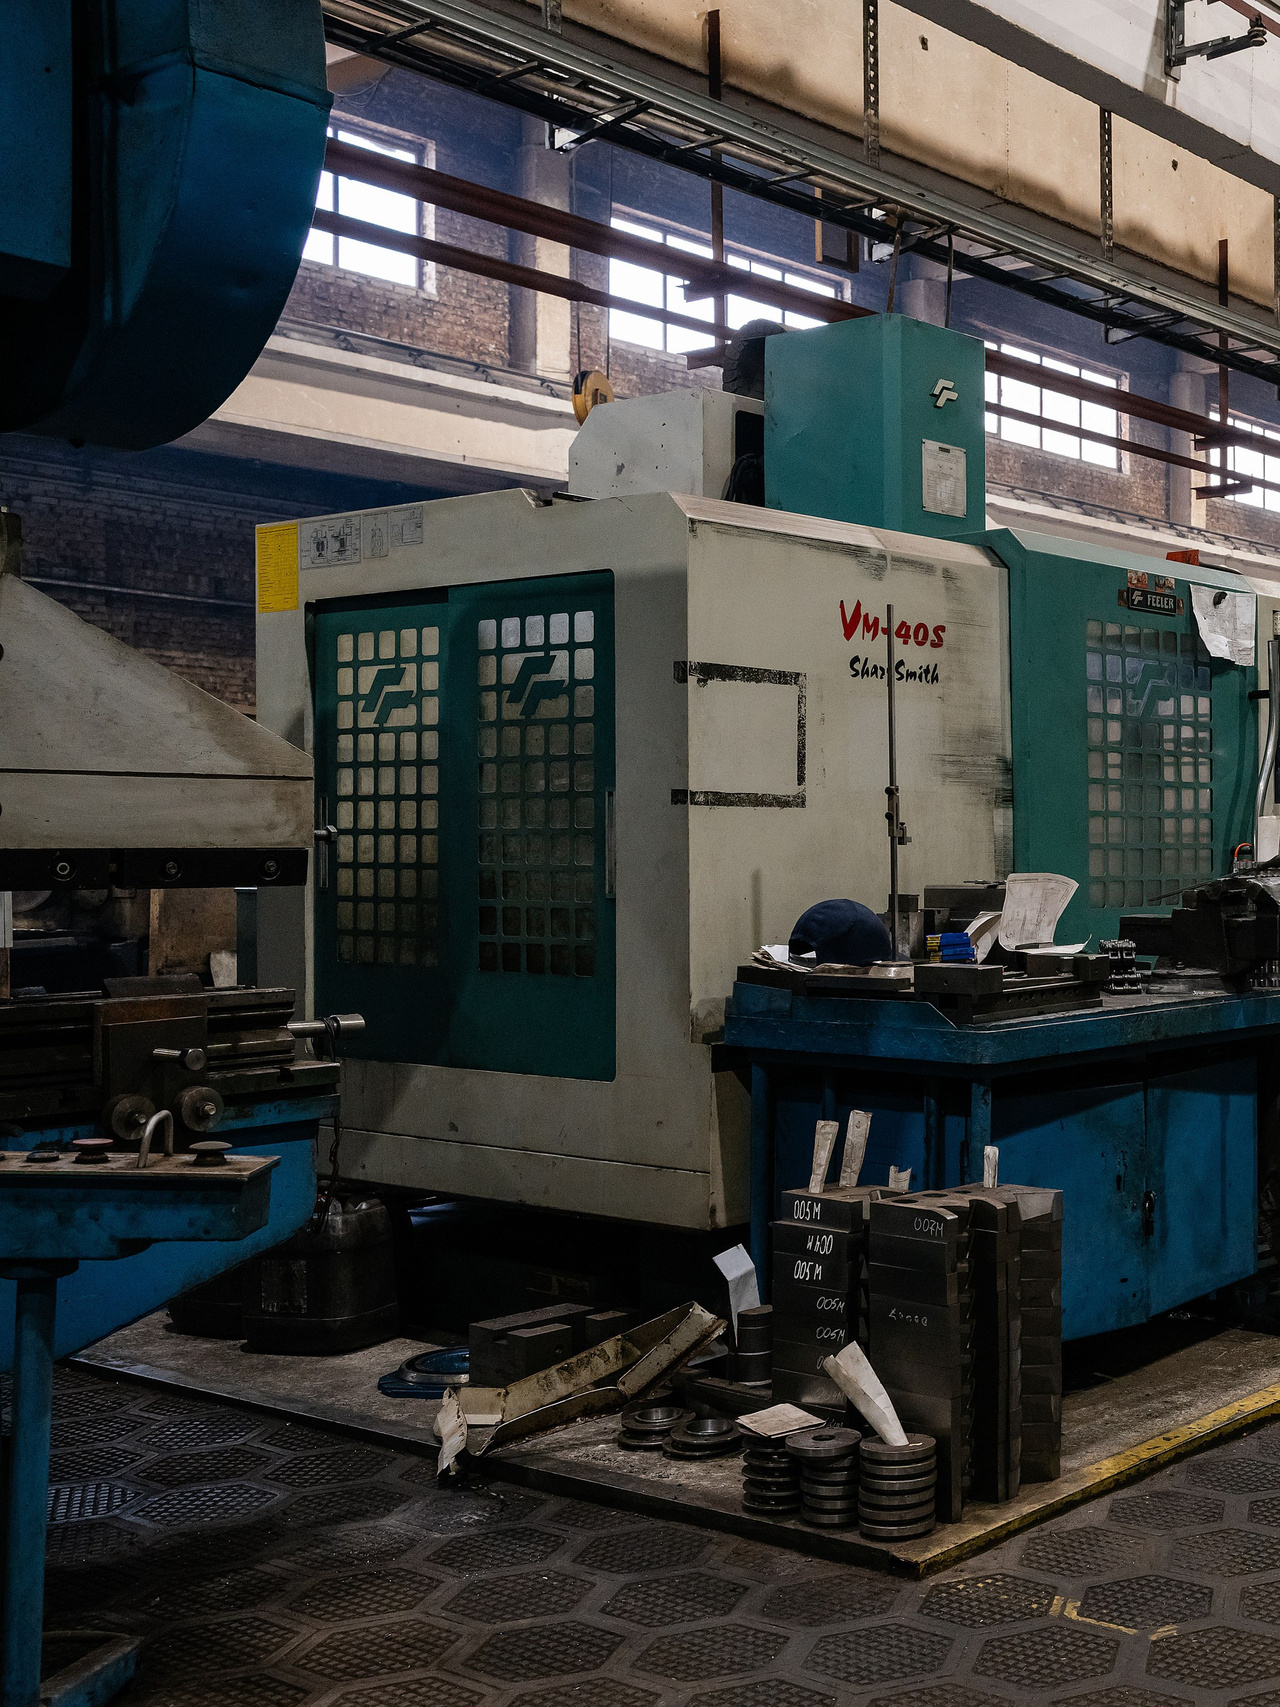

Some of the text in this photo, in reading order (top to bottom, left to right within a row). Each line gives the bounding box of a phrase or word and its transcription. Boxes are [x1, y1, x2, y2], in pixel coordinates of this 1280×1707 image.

[1147, 594, 1174, 609] FEELER
[839, 599, 946, 648] VM-40S
[895, 659, 940, 685] Smith
[793, 1199, 821, 1221] 005M
[793, 1259, 823, 1281] 005M
[816, 1296, 846, 1314] 005M
[815, 1325, 846, 1344] 005M
